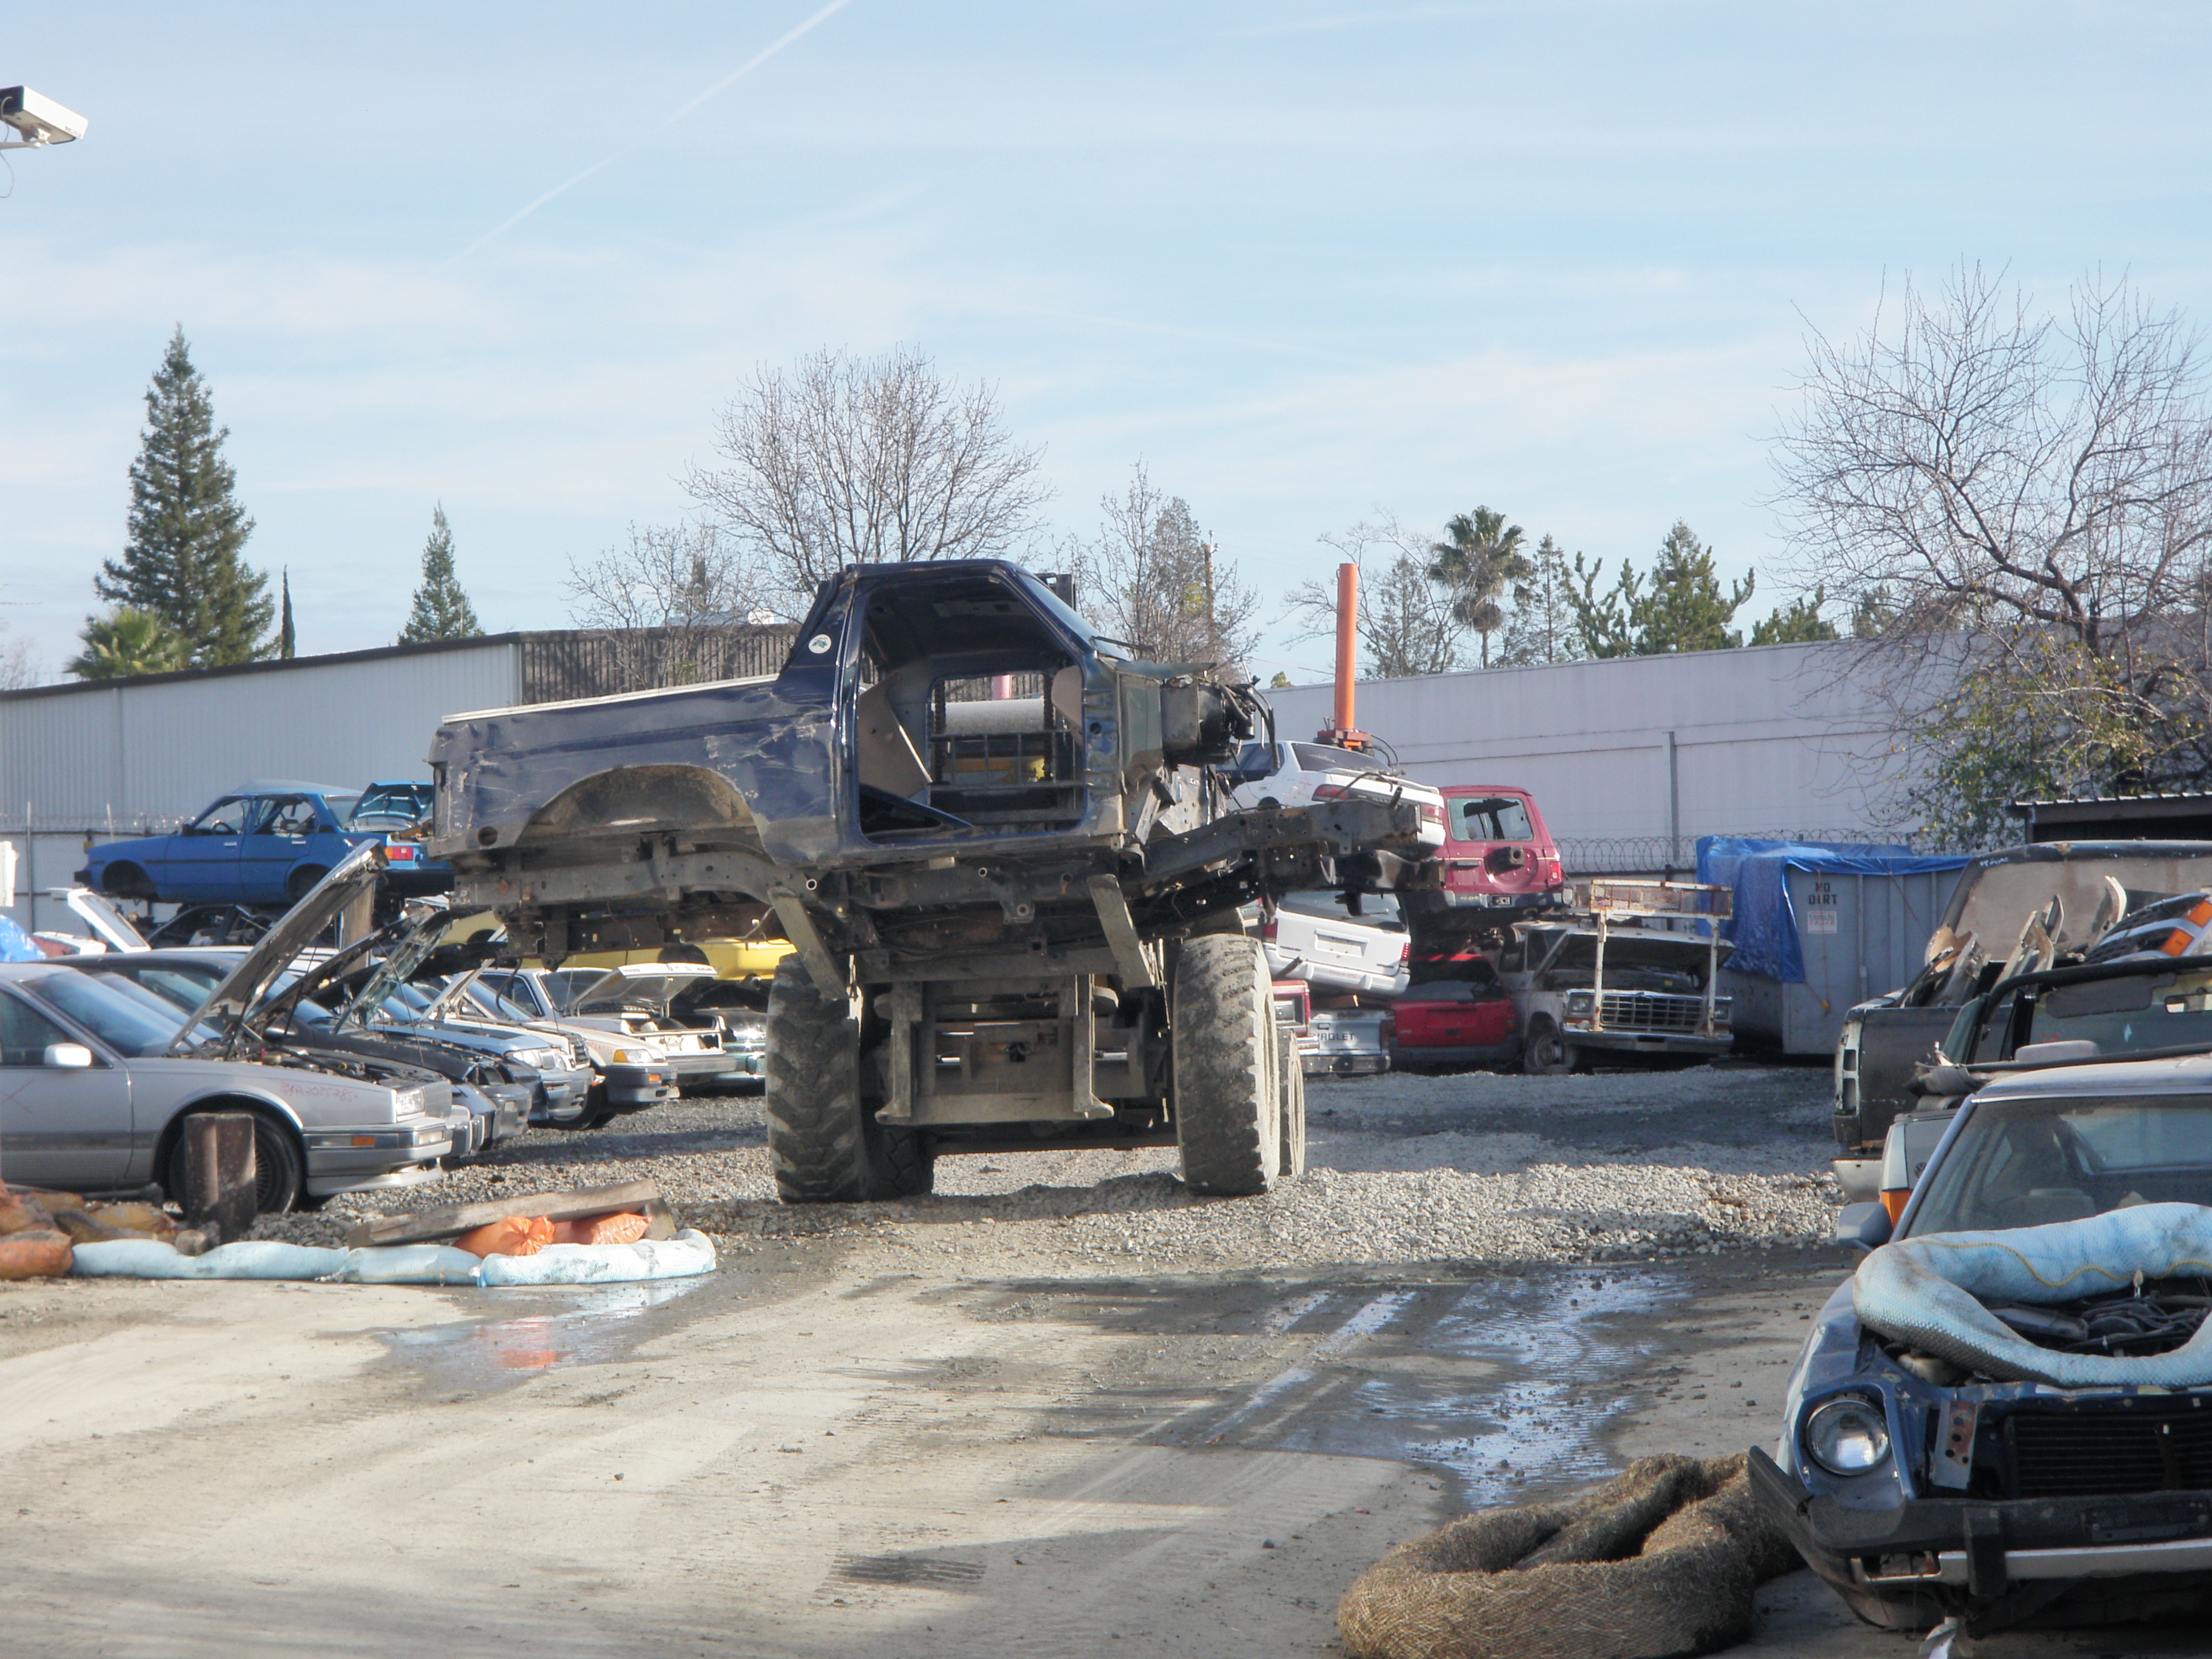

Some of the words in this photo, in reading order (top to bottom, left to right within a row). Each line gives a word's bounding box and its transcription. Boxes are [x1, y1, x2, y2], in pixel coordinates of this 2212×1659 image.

[1815, 882, 1830, 893] NO
[1809, 894, 1837, 905] DIRT
[1310, 1033, 1355, 1042] VROLET
